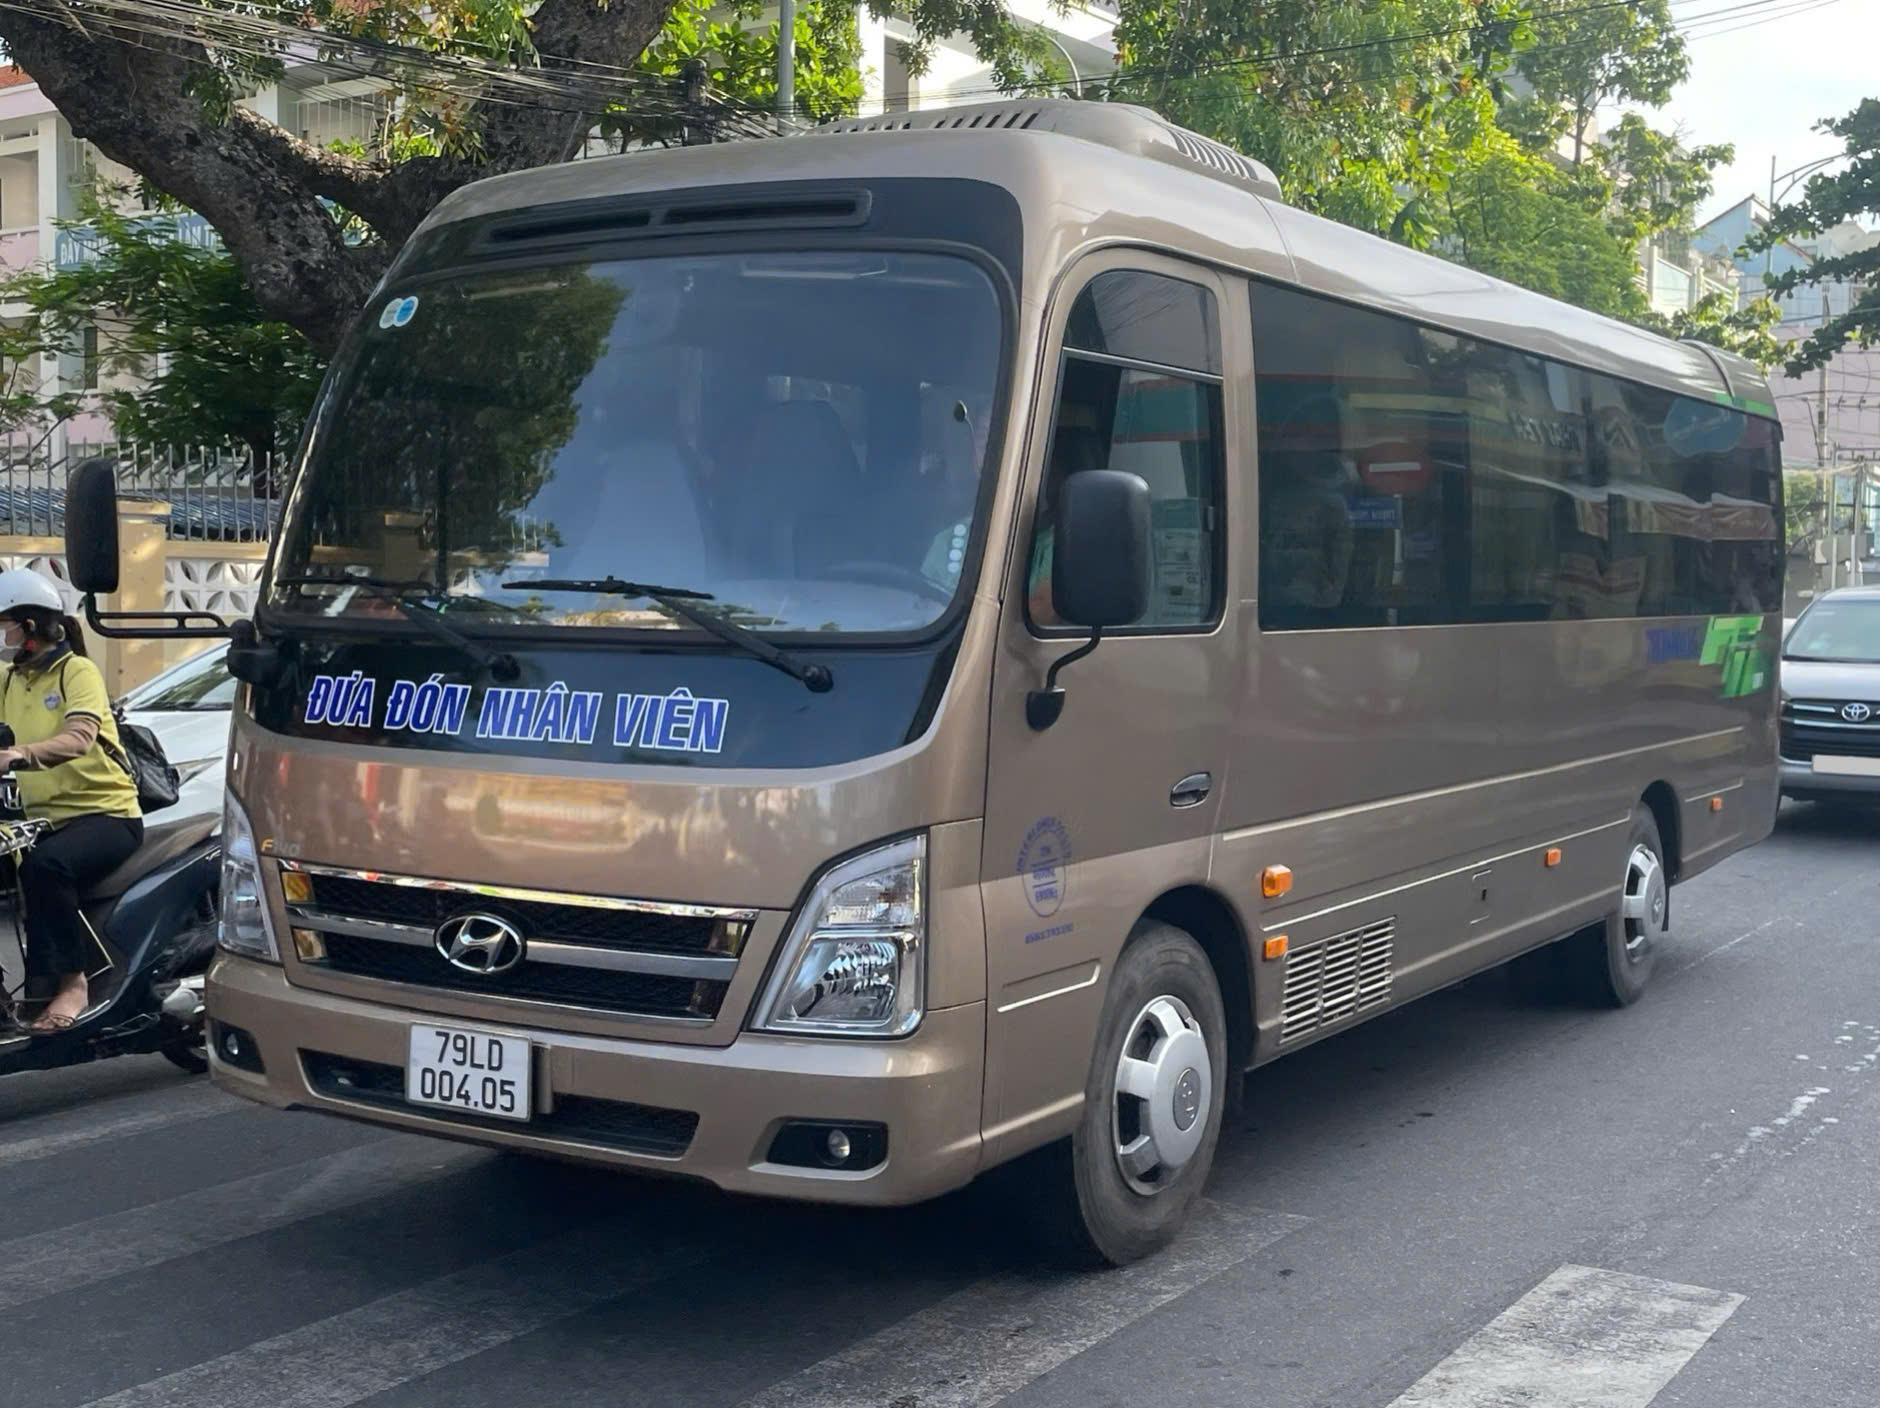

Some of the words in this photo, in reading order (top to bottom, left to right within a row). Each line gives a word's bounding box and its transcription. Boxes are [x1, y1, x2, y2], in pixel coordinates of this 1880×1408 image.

[304, 670, 376, 727] ĐƯA
[384, 673, 472, 735] ĐÓN
[476, 680, 603, 744] NHÂN
[613, 687, 729, 753] VIÊN
[435, 1030, 503, 1072] 79LD
[420, 1067, 516, 1113] 004.05
